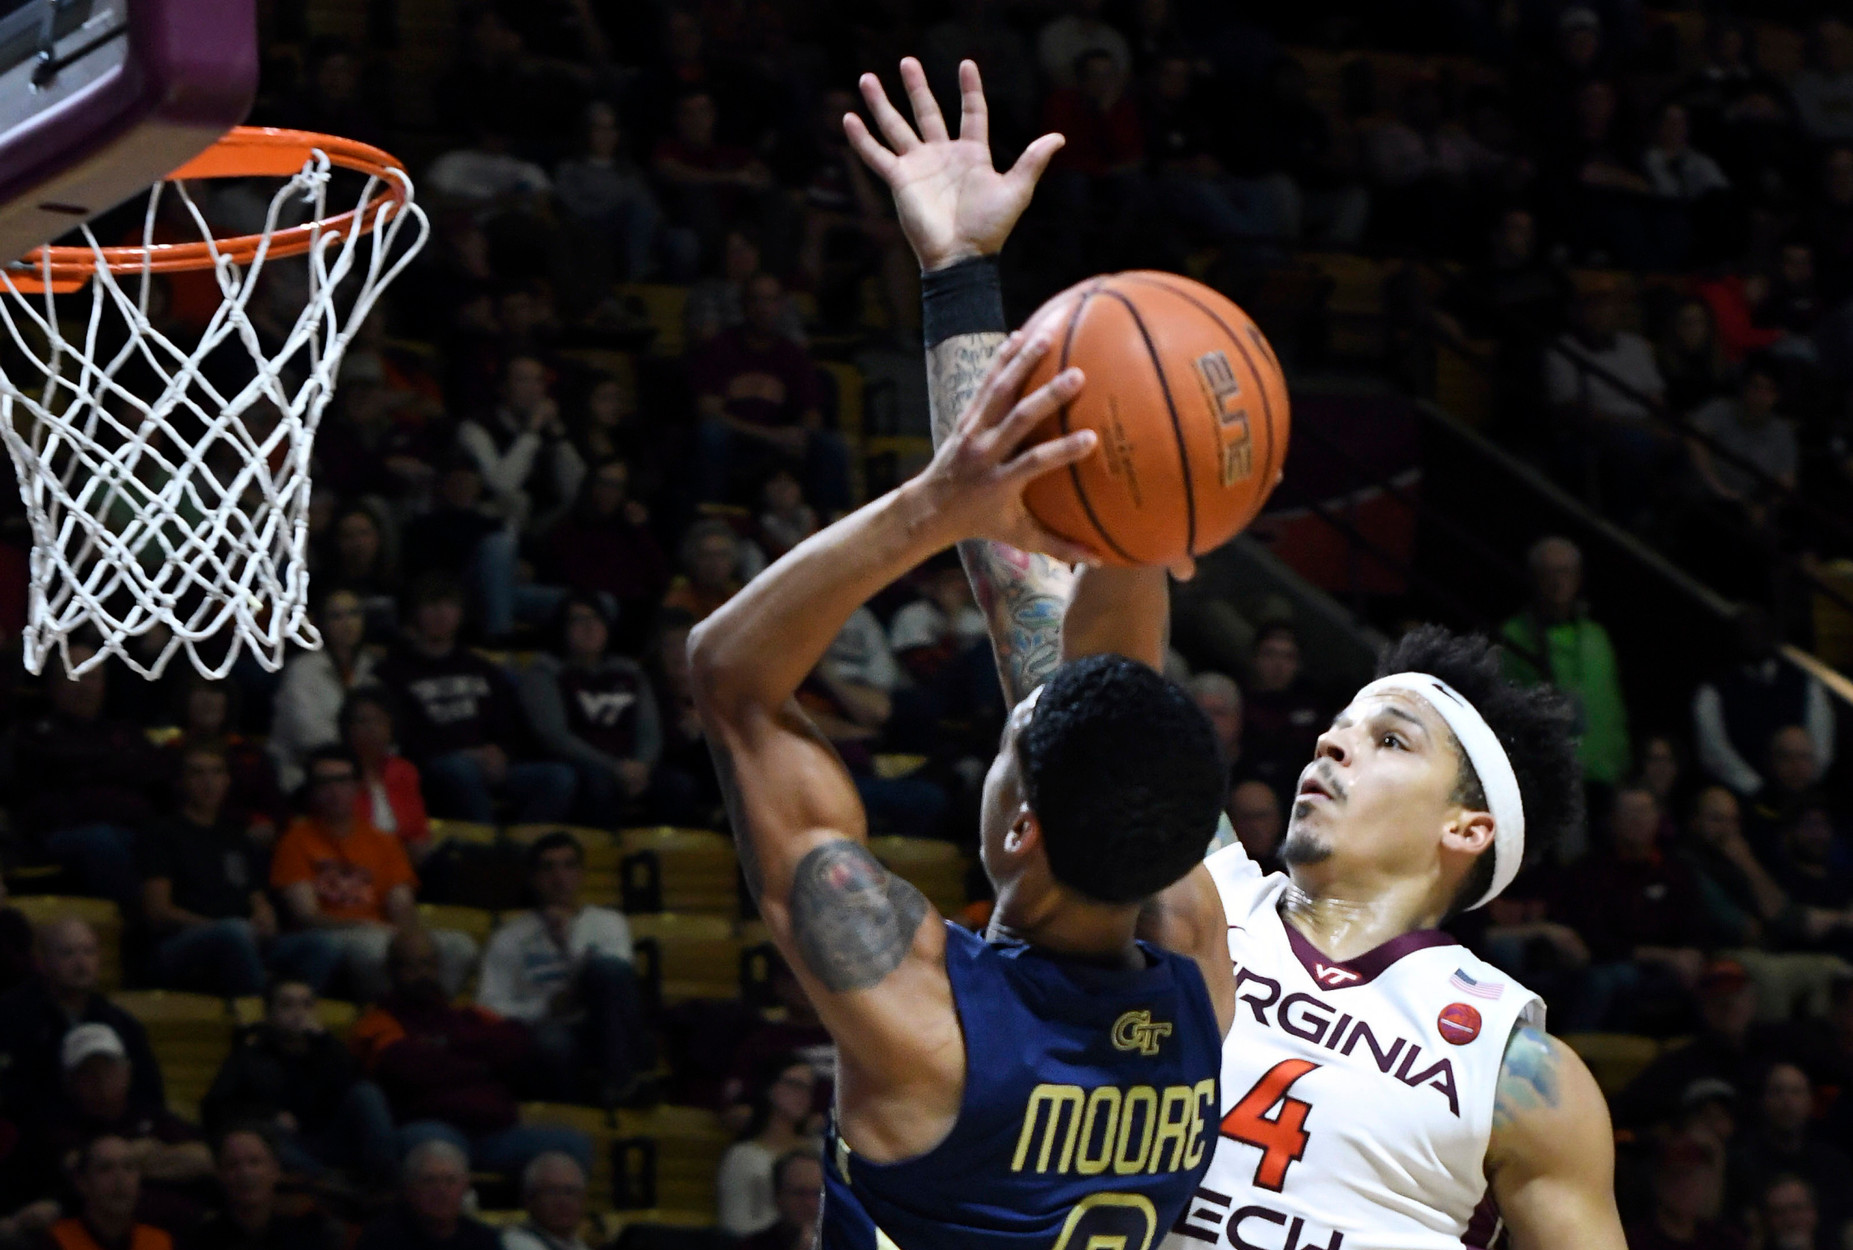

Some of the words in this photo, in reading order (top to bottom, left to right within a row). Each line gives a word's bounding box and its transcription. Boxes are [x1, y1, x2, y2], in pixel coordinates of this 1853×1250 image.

[1314, 962, 1361, 986] VT
[1111, 1010, 1172, 1056] GT
[1233, 961, 1460, 1118] RGINIA
[1011, 1078, 1215, 1176] MOORE
[1219, 1058, 1324, 1194] 4
